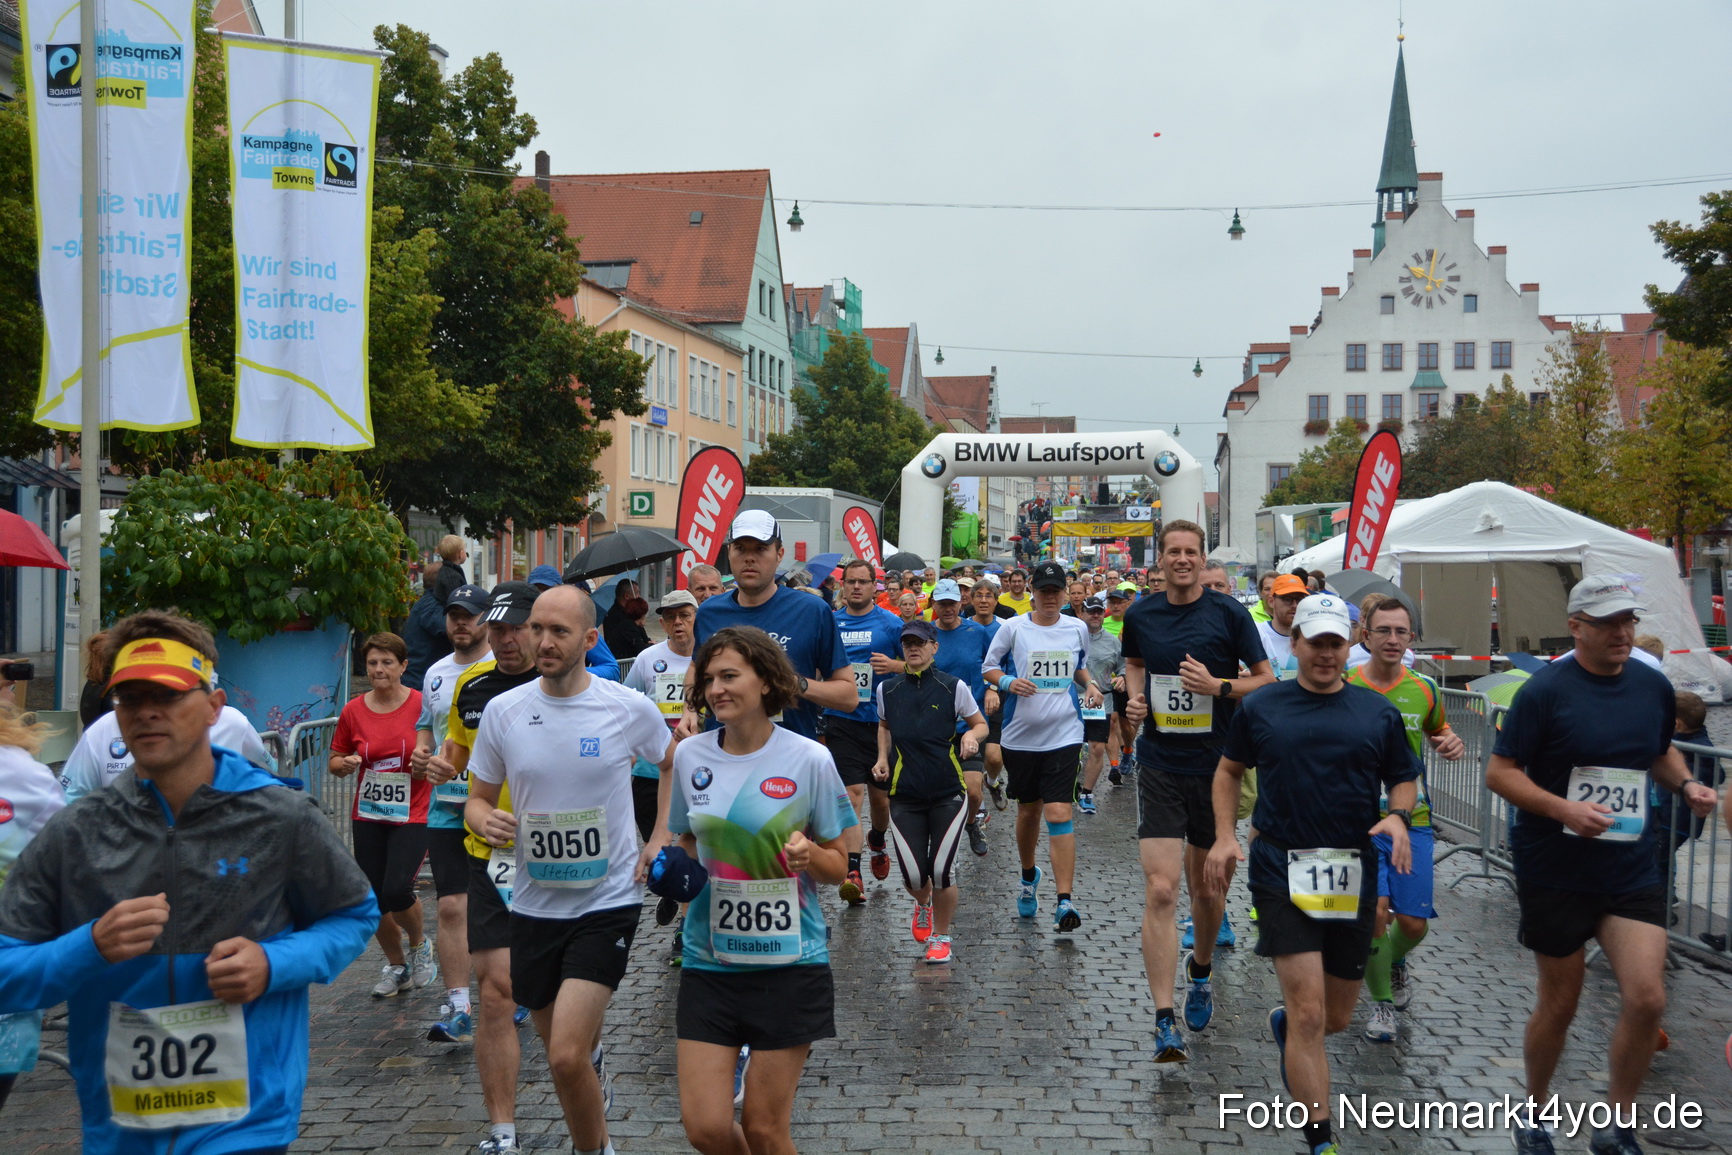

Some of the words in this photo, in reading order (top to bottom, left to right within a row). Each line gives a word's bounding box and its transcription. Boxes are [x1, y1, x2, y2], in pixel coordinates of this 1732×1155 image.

[243, 136, 313, 152] Kampagne
[243, 149, 320, 168] Fairtrade
[274, 172, 314, 185] Towns
[325, 177, 356, 187] FAIRTRADE
[242, 254, 282, 276] Wir
[289, 256, 336, 281] sind
[242, 286, 357, 313] Fairtrade-
[247, 319, 315, 340] Stadt!
[954, 442, 1021, 461] BMW
[1027, 441, 1145, 465] Laufsport
[633, 495, 650, 512] D
[1349, 451, 1394, 569] REWE
[1092, 525, 1115, 534] ZIEL
[1033, 660, 1068, 676] 2111
[1168, 690, 1193, 711] 53
[1166, 716, 1194, 726] Robert
[583, 741, 598, 753] ZF
[363, 782, 406, 802] 2595
[451, 786, 468, 795] Heiko
[765, 781, 793, 794] Hervis
[1578, 783, 1638, 813] 2234
[556, 810, 598, 823] BOCK
[530, 827, 601, 859] 3050
[539, 864, 593, 880] Stefan
[1306, 865, 1348, 891] 114
[747, 882, 790, 893] BOCK
[1323, 898, 1334, 908] Uli
[718, 899, 791, 931] 2863
[728, 939, 781, 952] Elisabeth
[160, 1005, 230, 1026] BOCK
[132, 1033, 218, 1080] 302
[135, 1089, 216, 1111] Matthias
